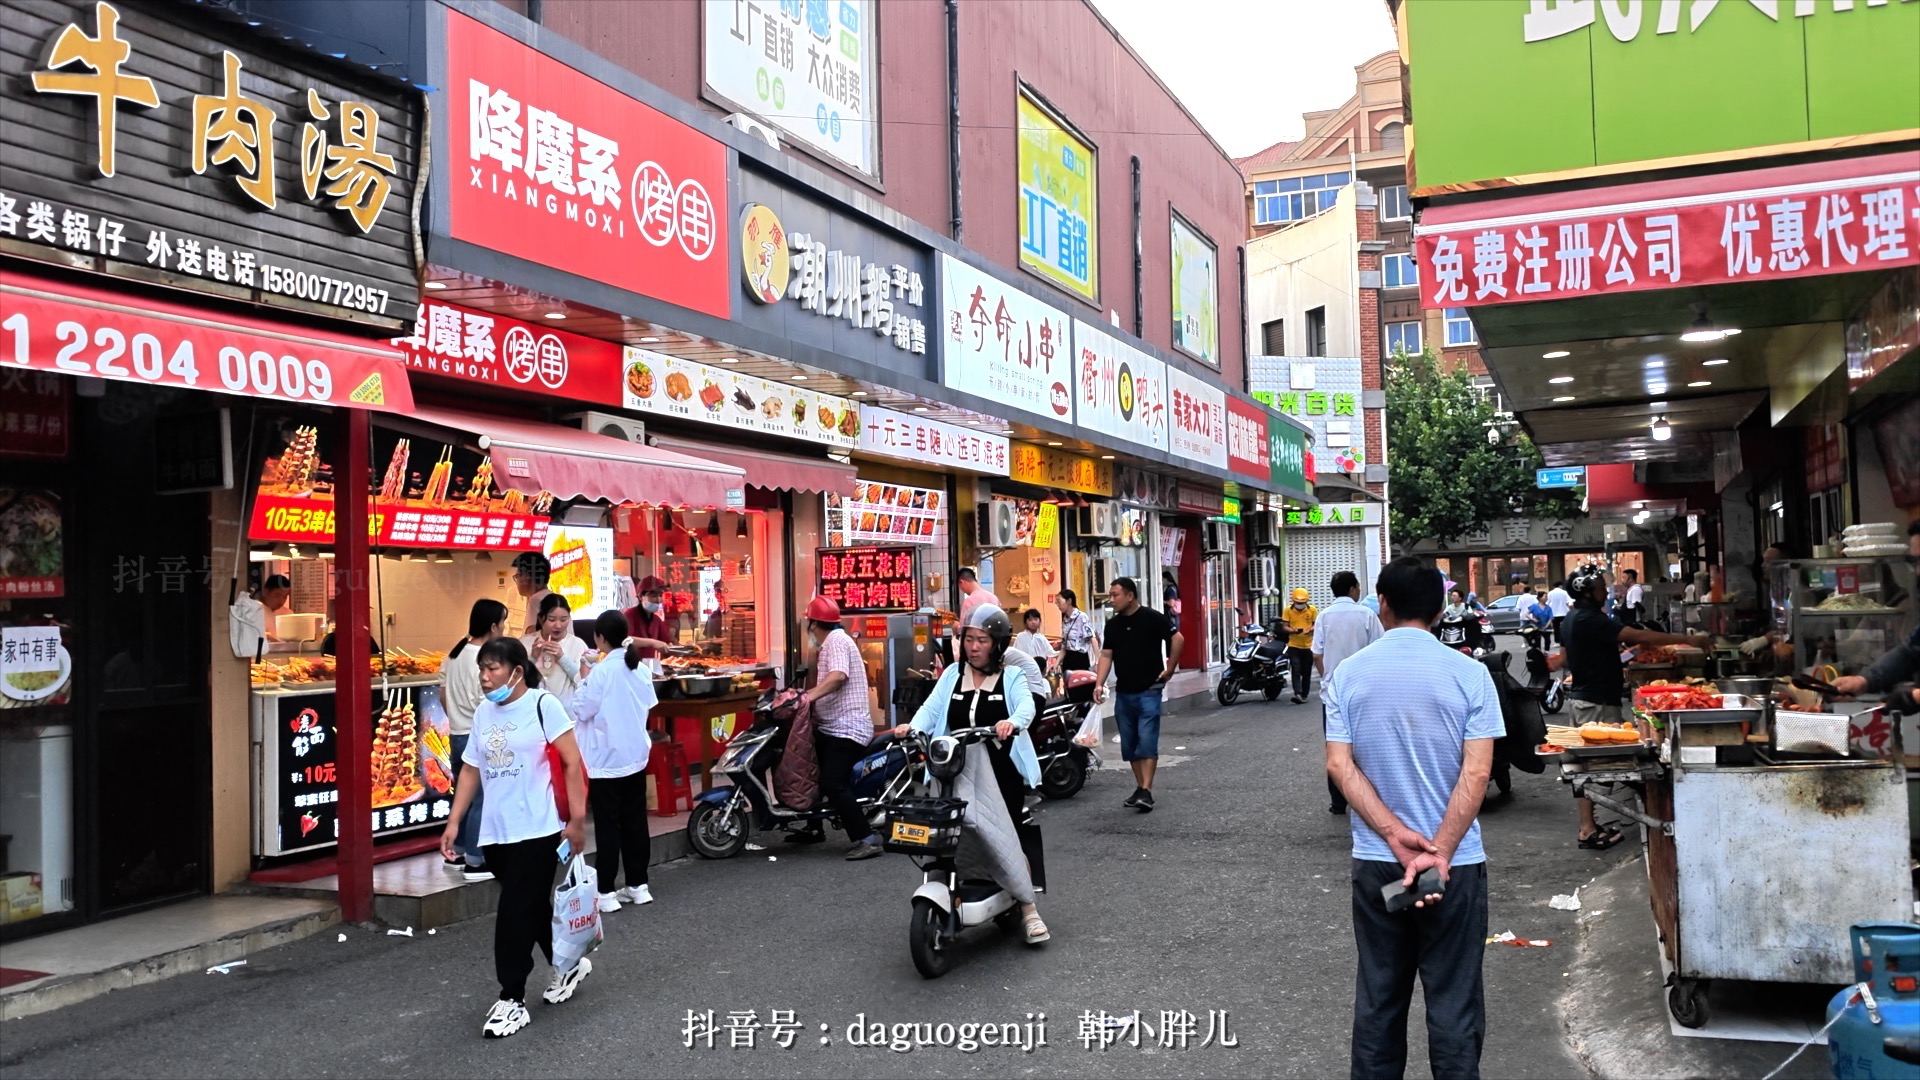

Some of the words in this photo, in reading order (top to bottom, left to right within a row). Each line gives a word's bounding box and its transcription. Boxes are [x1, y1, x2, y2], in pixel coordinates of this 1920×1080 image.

[808, 44, 860, 114] 大众消费
[469, 78, 622, 210] 降魔系
[637, 166, 712, 258] 烤串
[469, 166, 625, 238] XIANGMOXI
[1022, 187, 1088, 282] 工厂直销
[1431, 214, 1682, 304] 免费注册公司
[1720, 187, 1920, 278] 优惠代理
[890, 264, 925, 307] 平价
[55, 321, 199, 386] 2204
[219, 345, 332, 400] 0009
[506, 328, 566, 386] 烤串
[892, 313, 926, 355] 销售
[969, 284, 1055, 374] 夺命小串
[402, 352, 498, 381] IANGMOXI
[867, 414, 1007, 470] 十元三串随心选可混搭
[822, 552, 911, 580] 脆皮五花肉
[5, 637, 59, 664] 家中有事
